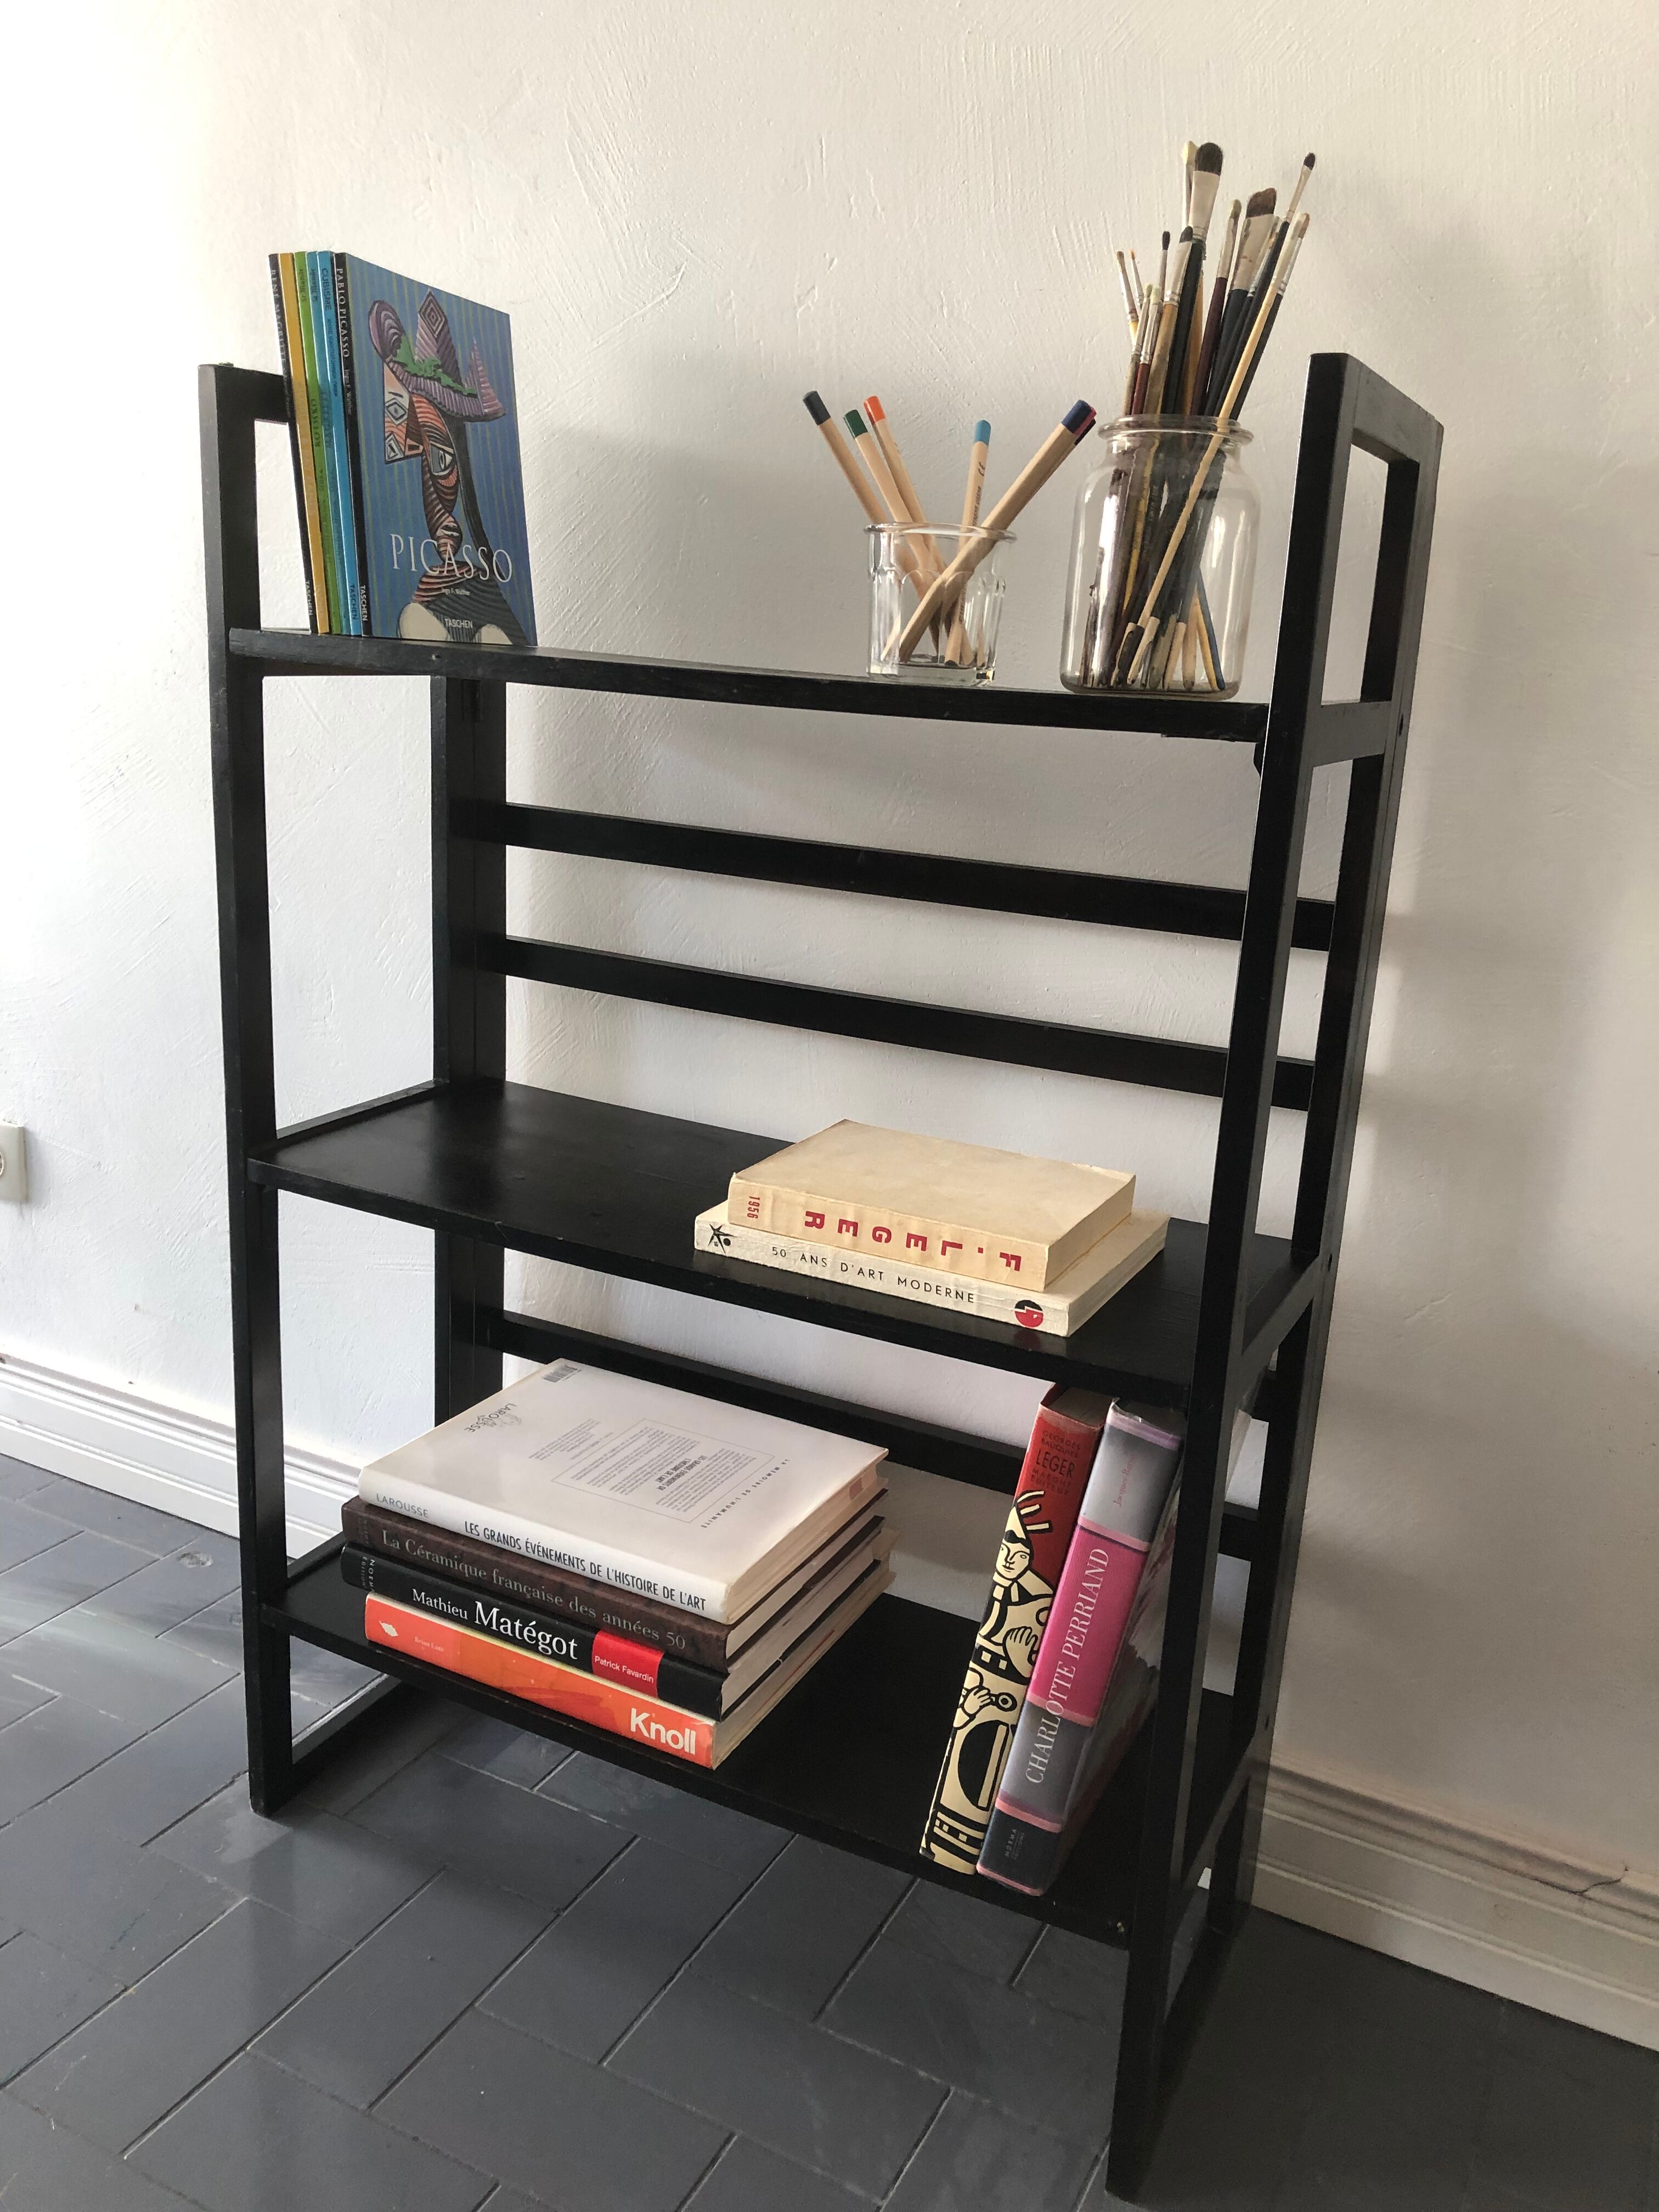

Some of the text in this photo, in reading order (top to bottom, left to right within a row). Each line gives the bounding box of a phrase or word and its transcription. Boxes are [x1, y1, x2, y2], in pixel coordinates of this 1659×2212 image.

[322, 268, 331, 311] CUBISME
[336, 268, 350, 357] PABLO PICASSO
[274, 304, 286, 364] MAGRITTE
[311, 398, 320, 447] ROTHKO
[390, 534, 512, 583] PICASSO
[305, 580, 313, 616] TASCHEN
[349, 584, 359, 620] TASCHEN
[360, 585, 368, 621] TASCHEN
[444, 618, 473, 629] TASCHEN
[747, 1195, 760, 1219] 1956
[772, 1246, 974, 1304] 50 ANS D'ART MODERNE
[464, 1403, 517, 1432] LAROUSSE
[1043, 1430, 1080, 1451] GEORGES
[1036, 1448, 1075, 1478] LEGER
[376, 1493, 429, 1518] LAROUSSE
[465, 1521, 706, 1611] LES GRANDS ÉVÉNEMENTS DE L'HISTOIRE DE L'ART
[382, 1530, 400, 1549] La
[405, 1538, 487, 1579] Céramique
[492, 1568, 563, 1606] française
[569, 1596, 596, 1618] des
[603, 1612, 659, 1641] années
[666, 1632, 686, 1650] 50
[412, 1588, 578, 1660] Mathieu Matégot
[414, 1636, 430, 1647] Brian
[595, 1655, 654, 1684] Patrick Favardin
[1025, 1548, 1109, 1784] CHARLOTTE PERRIAND
[630, 1707, 696, 1755] Knoll
